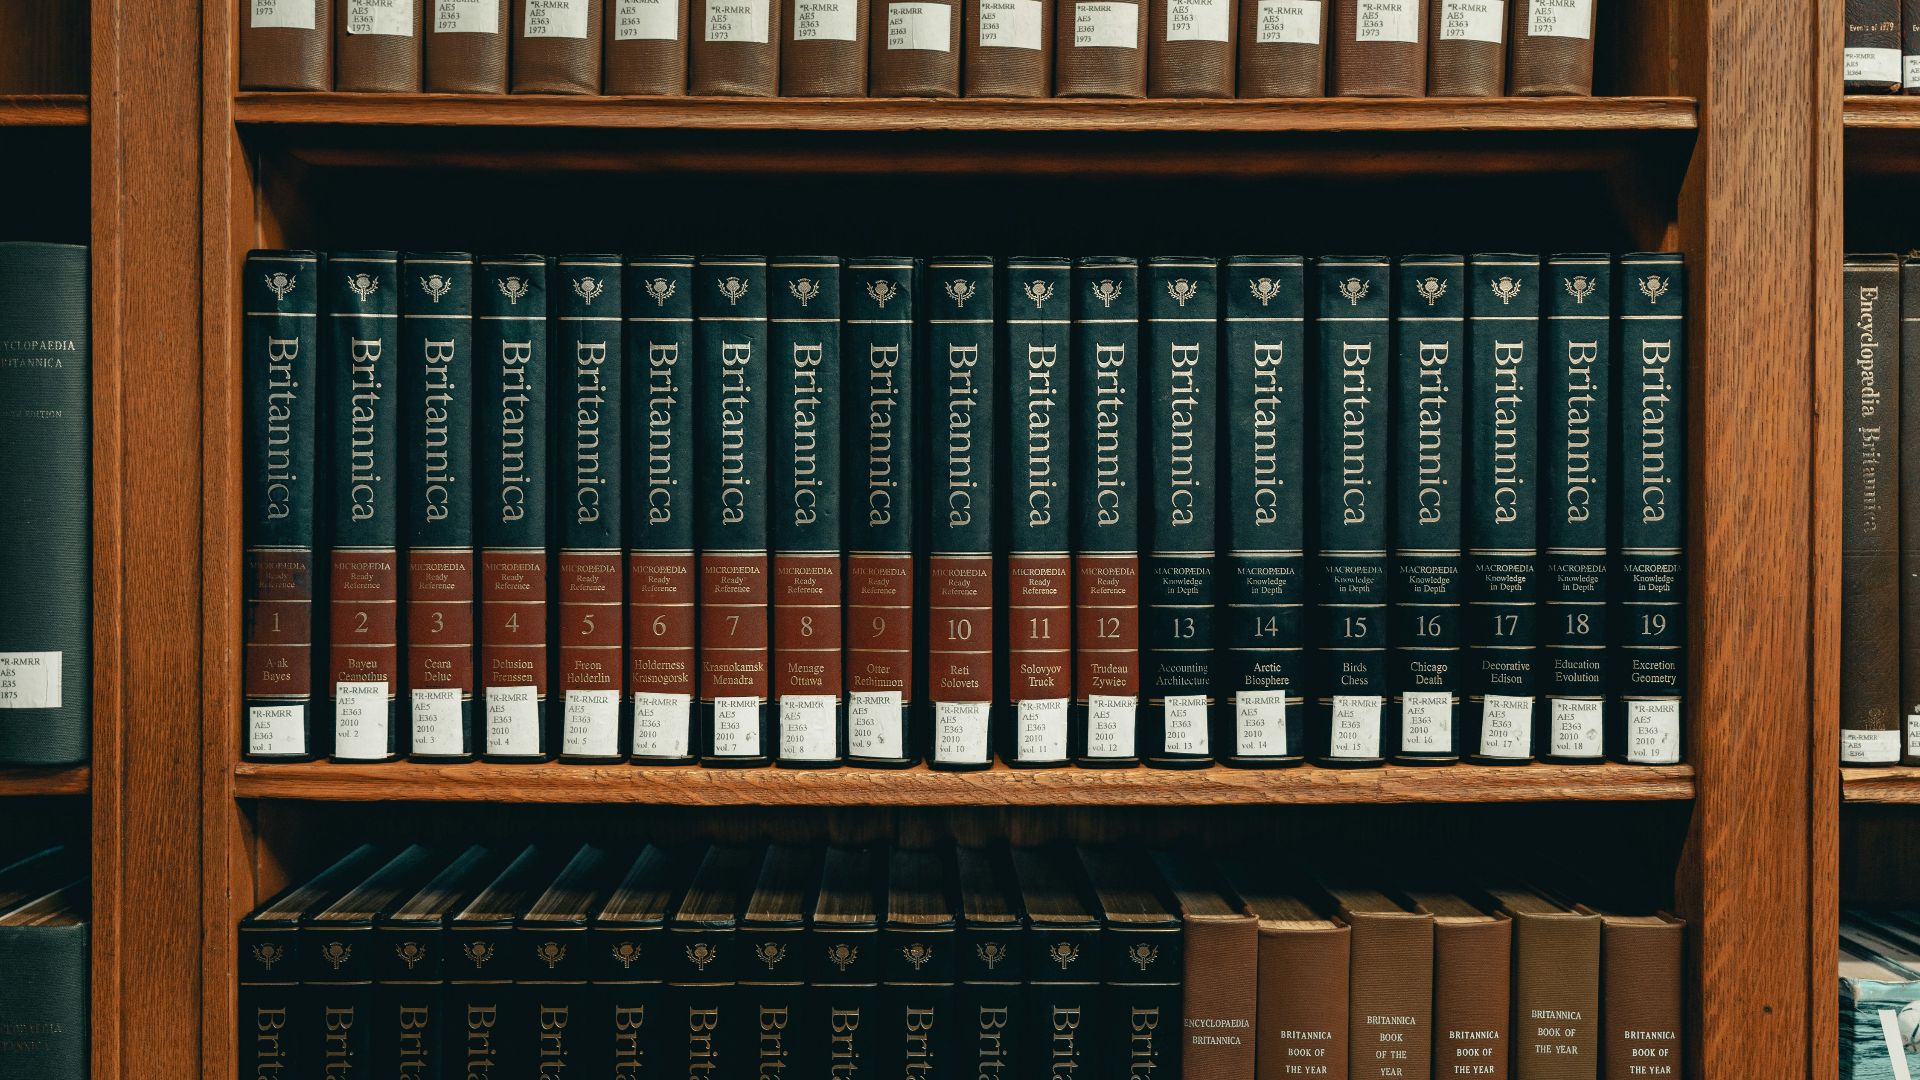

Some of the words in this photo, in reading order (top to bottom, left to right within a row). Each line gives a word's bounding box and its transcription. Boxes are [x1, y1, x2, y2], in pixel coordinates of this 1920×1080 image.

[799, 12, 815, 20] AE5
[1362, 12, 1379, 20] AE5
[529, 26, 546, 34] 1973
[799, 28, 817, 37] 1973
[1361, 28, 1380, 37] 1973
[1076, 35, 1092, 43] 1973
[268, 336, 299, 521] Britannica
[352, 337, 381, 522] Britannica
[424, 338, 455, 523] Britannica
[502, 339, 532, 523] Britannica
[577, 340, 606, 525] Britannica
[650, 341, 679, 525] Britannica
[722, 341, 751, 526] Britannica
[1171, 342, 1200, 526] Britannica
[1254, 340, 1283, 526] Britannica
[1343, 341, 1372, 526] Britannica
[1420, 340, 1449, 526] Britannica
[1495, 340, 1524, 524] Britannica
[1568, 339, 1597, 524] Britannica
[1642, 339, 1671, 524] Britannica
[793, 342, 822, 527] Britannica
[869, 342, 899, 528] Britannica
[950, 342, 978, 528] Britannica
[1028, 343, 1057, 528] Britannica
[1097, 342, 1126, 528] Britannica
[1861, 427, 1881, 533] Britannica
[1029, 579, 1050, 587] Ready
[1261, 587, 1282, 595] Depth
[272, 613, 281, 631] 1
[355, 612, 368, 632] 2
[431, 612, 443, 632] 3
[505, 613, 519, 632] 4
[581, 615, 594, 635] 5
[653, 615, 666, 635] 6
[726, 616, 739, 635] 7
[801, 616, 812, 636] 8
[872, 617, 885, 637] 9
[1254, 616, 1278, 636] 14
[1344, 617, 1366, 638] 15
[1416, 615, 1441, 636] 16
[1495, 615, 1518, 636] 17
[1566, 614, 1589, 634] 18
[1641, 614, 1666, 635] 19
[948, 619, 972, 640] 10
[1030, 618, 1050, 638] 11
[1097, 618, 1120, 638] 12
[1174, 618, 1195, 638] 13
[348, 659, 377, 670] Bayeu
[493, 659, 533, 669] Delusion
[635, 660, 684, 669] Holderness
[704, 662, 764, 672] Krasnokamsk
[867, 664, 890, 673] Otter
[1020, 664, 1061, 675] Solovyov
[1091, 664, 1128, 673] Trudeau
[1159, 663, 1208, 674] Accounting
[1254, 663, 1281, 672] Arctic
[1343, 663, 1367, 672] Birds
[1411, 662, 1447, 673] Chicago
[1482, 661, 1530, 671] Decorative
[1555, 659, 1600, 669] Education
[1633, 660, 1675, 670] Excretion
[0, 669, 16, 677] AE5
[263, 671, 291, 682] Bayes
[339, 672, 388, 681] Ceanothus
[425, 672, 451, 681] Deluc
[493, 672, 533, 682] Frenssen
[632, 673, 688, 684] Krasnogorsk
[1555, 672, 1599, 682] Evolution
[713, 675, 753, 684] Menadra
[790, 676, 822, 685] Ottawa
[941, 678, 979, 688] Solovets
[1029, 677, 1054, 686] Truck
[1156, 676, 1209, 685] Architecture
[1245, 675, 1289, 687] Biosphere
[1341, 675, 1368, 685] Chess
[1416, 675, 1443, 684] Death
[1491, 674, 1522, 684] Edison
[1632, 673, 1676, 685] Geometry
[1367, 1016, 1416, 1025] BRITANNICA
[1532, 1010, 1581, 1020] BRITANNICA
[1184, 1019, 1249, 1028] ENCYCLOPAEDIA
[1281, 1031, 1331, 1040] BRITANNICA
[1380, 1033, 1403, 1042] BOOK
[1449, 1031, 1499, 1040] BRITANNICA
[1538, 1028, 1561, 1037] BOOK
[1565, 1028, 1576, 1037] OF
[1625, 1030, 1675, 1040] BRITANNICA
[258, 1006, 285, 1080] Brit
[400, 1004, 428, 1080] Brit
[540, 1004, 568, 1080] Brit
[690, 1006, 718, 1080] Brit
[832, 1006, 859, 1080] Brit
[979, 1005, 1007, 1080] Brit
[1131, 1006, 1158, 1080] Brit
[1192, 1036, 1241, 1045] BRITANNICA
[1288, 1048, 1311, 1057] BOOK
[1314, 1048, 1324, 1057] OF
[1376, 1050, 1387, 1059] OF
[1391, 1050, 1407, 1059] THE
[1456, 1048, 1479, 1057] BOOK
[1482, 1048, 1492, 1057] OF
[1535, 1044, 1551, 1053] THE
[1556, 1045, 1578, 1054] YEAR
[1632, 1049, 1655, 1057] BOOK
[1658, 1049, 1668, 1057] OF
[1286, 1065, 1302, 1074] THE
[1306, 1066, 1327, 1074] YEAR
[1380, 1068, 1402, 1076] YEAR
[1454, 1065, 1470, 1074] THE
[1473, 1065, 1494, 1074] YEAR
[1630, 1065, 1646, 1074] THE
[1649, 1066, 1671, 1074] YEAR
